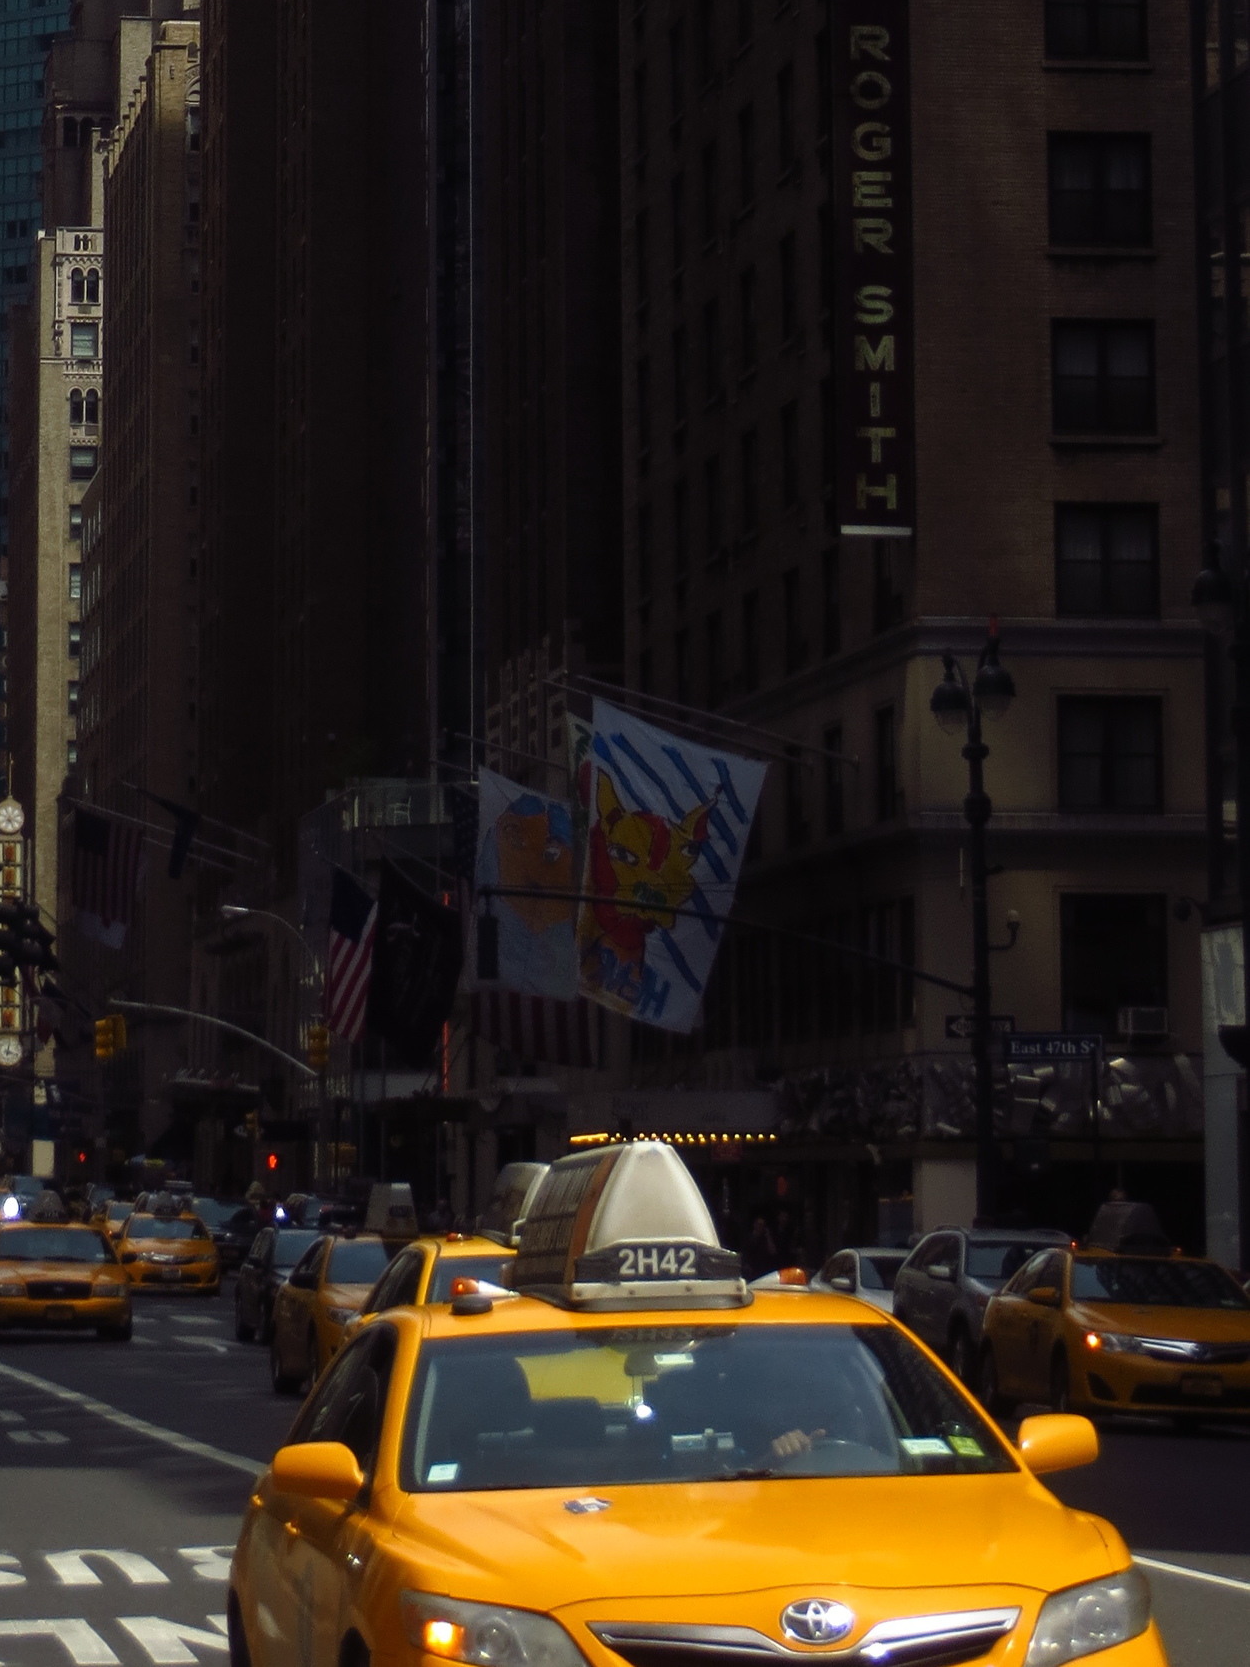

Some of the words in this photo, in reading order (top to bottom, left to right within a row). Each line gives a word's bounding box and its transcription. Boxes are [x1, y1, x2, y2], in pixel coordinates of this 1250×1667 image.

[849, 24, 895, 255] ROGER
[854, 284, 900, 512] SMITH
[1010, 1040, 1041, 1054] East
[1045, 1040, 1077, 1054] 47th
[617, 1247, 697, 1277] 2H42
